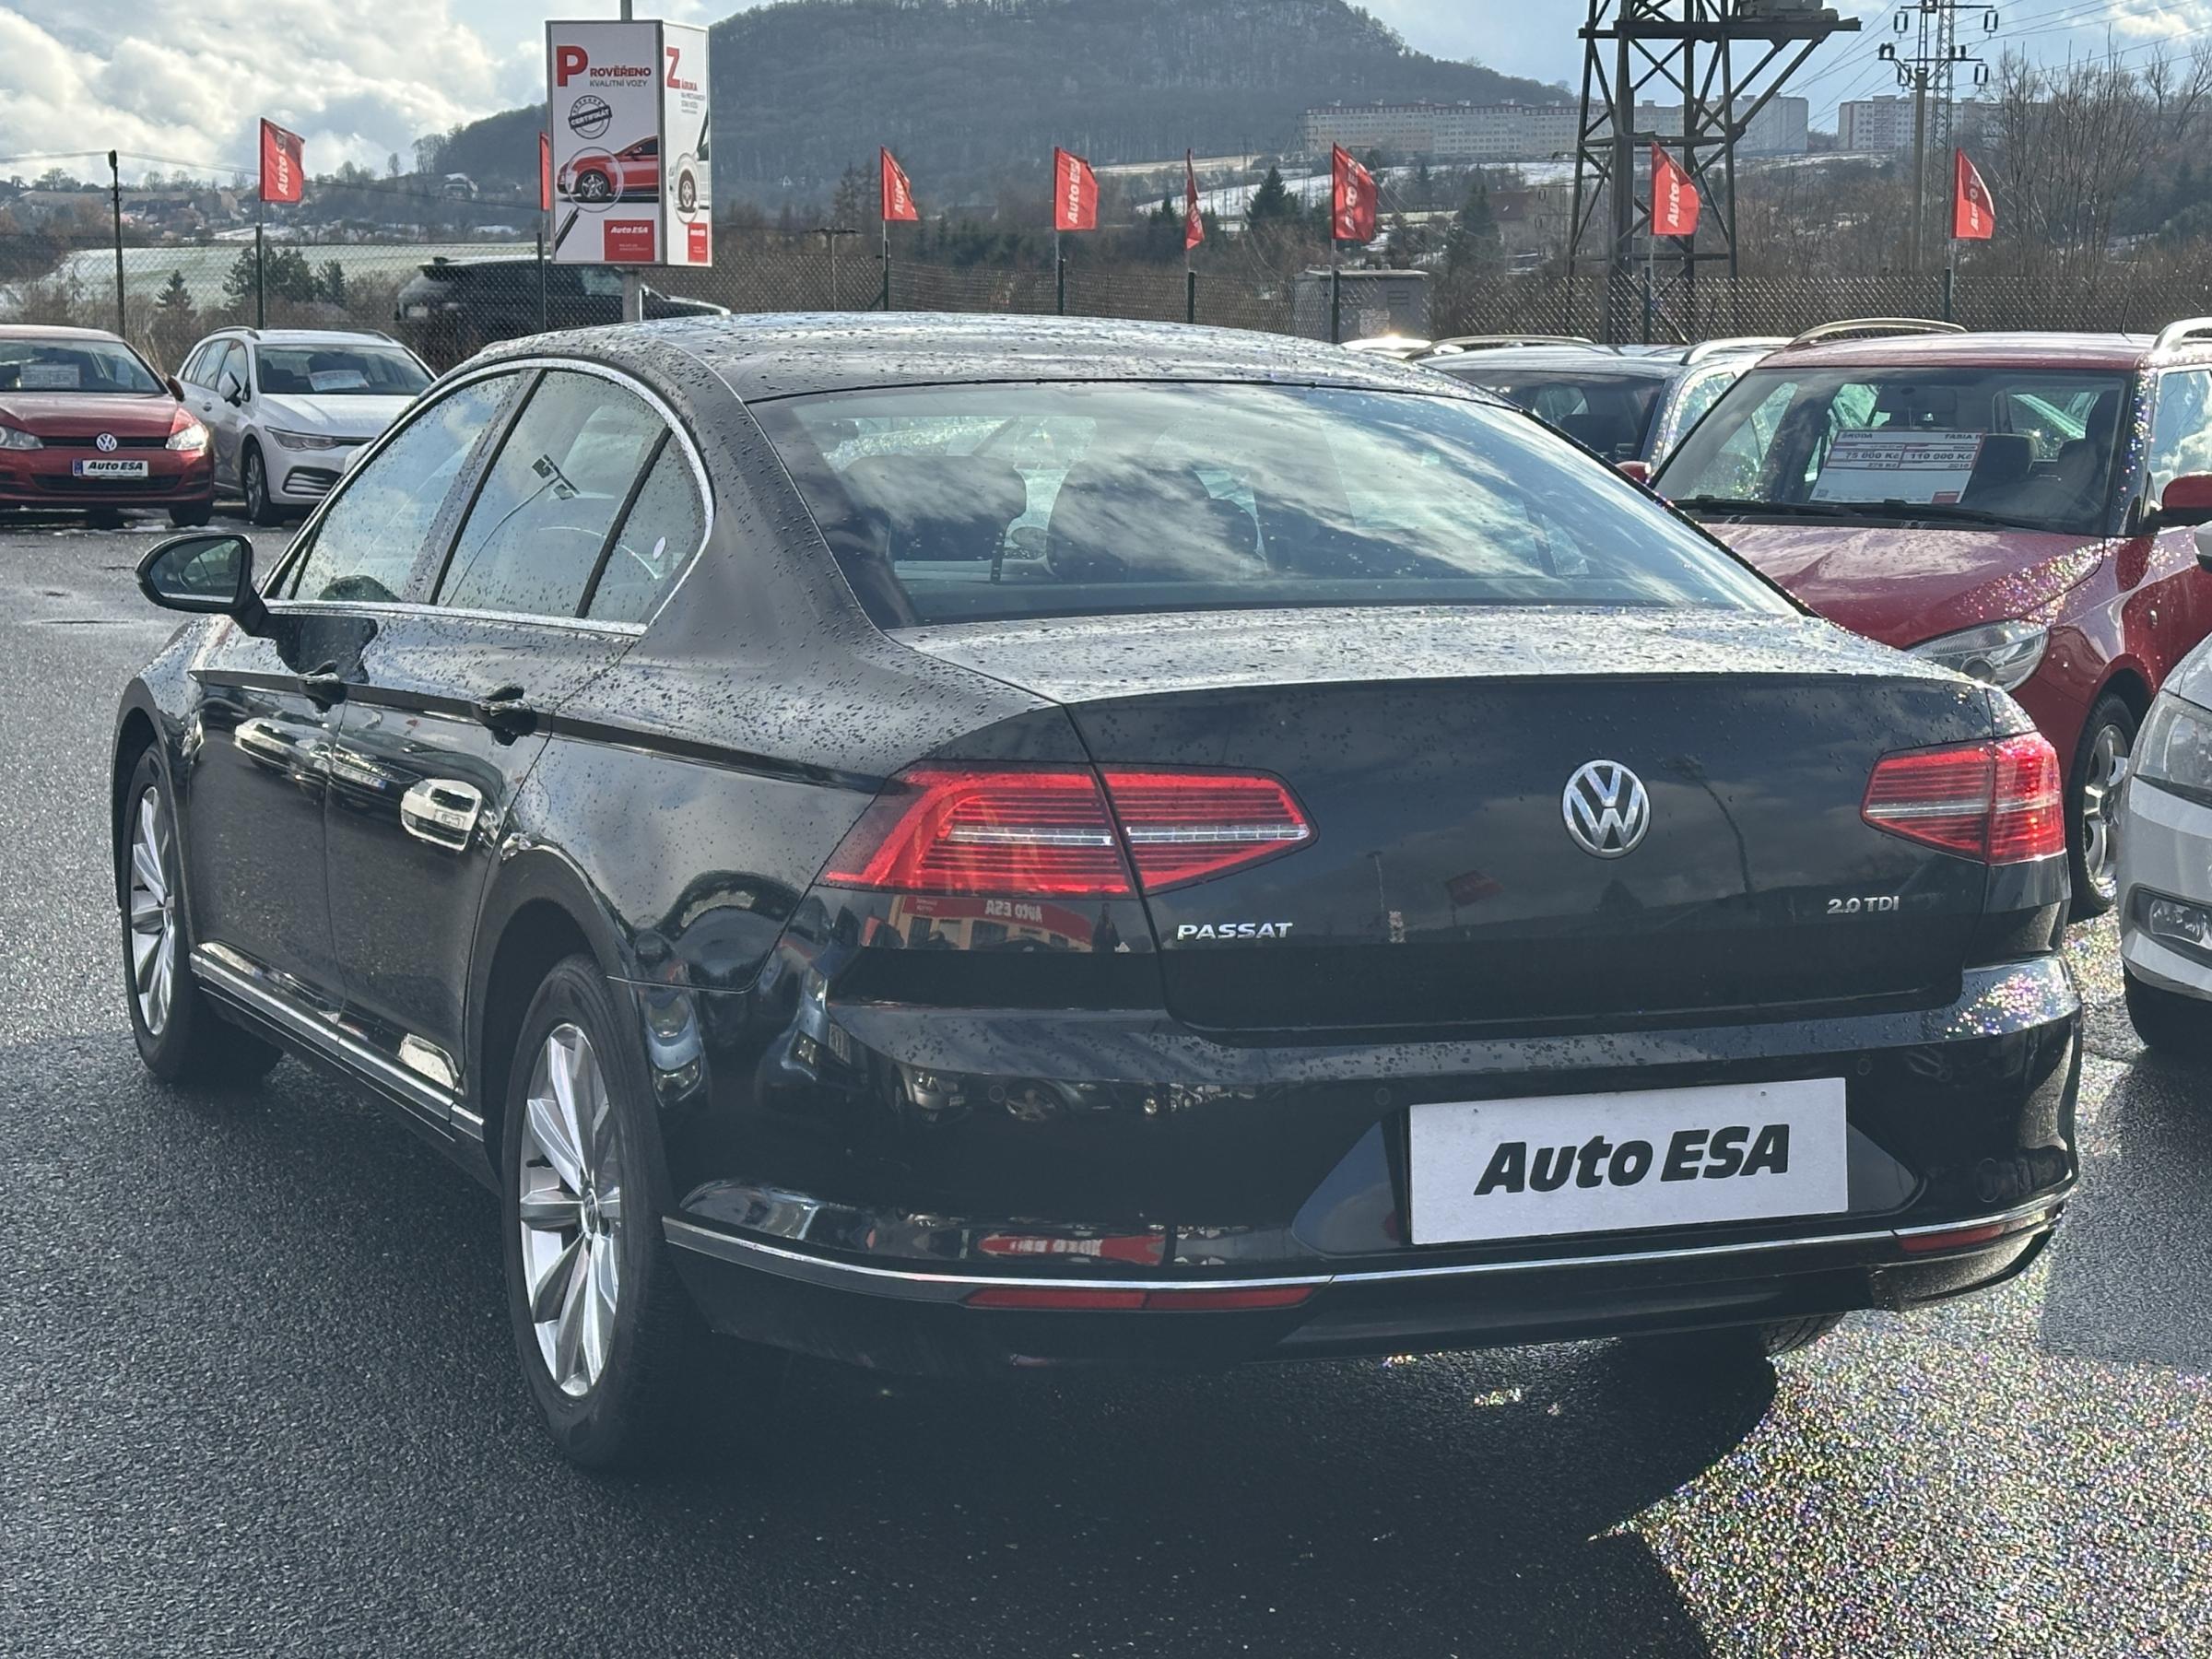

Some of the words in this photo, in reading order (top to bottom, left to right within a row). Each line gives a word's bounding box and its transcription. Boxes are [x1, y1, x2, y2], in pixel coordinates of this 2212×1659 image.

[276, 156, 288, 196] Auto
[1067, 183, 1079, 225] Auto
[1667, 183, 1679, 229] Auto
[611, 226, 632, 234] Auto
[632, 226, 649, 234] ESA
[88, 461, 119, 470] Auto
[119, 462, 143, 471] ESA
[1562, 759, 1651, 859] VW
[1827, 897, 1861, 914] 2.0
[1864, 895, 1900, 912] TDI
[1177, 922, 1293, 940] PASSAT
[1473, 1135, 1653, 1195] Auto
[1660, 1124, 1790, 1182] ESA
